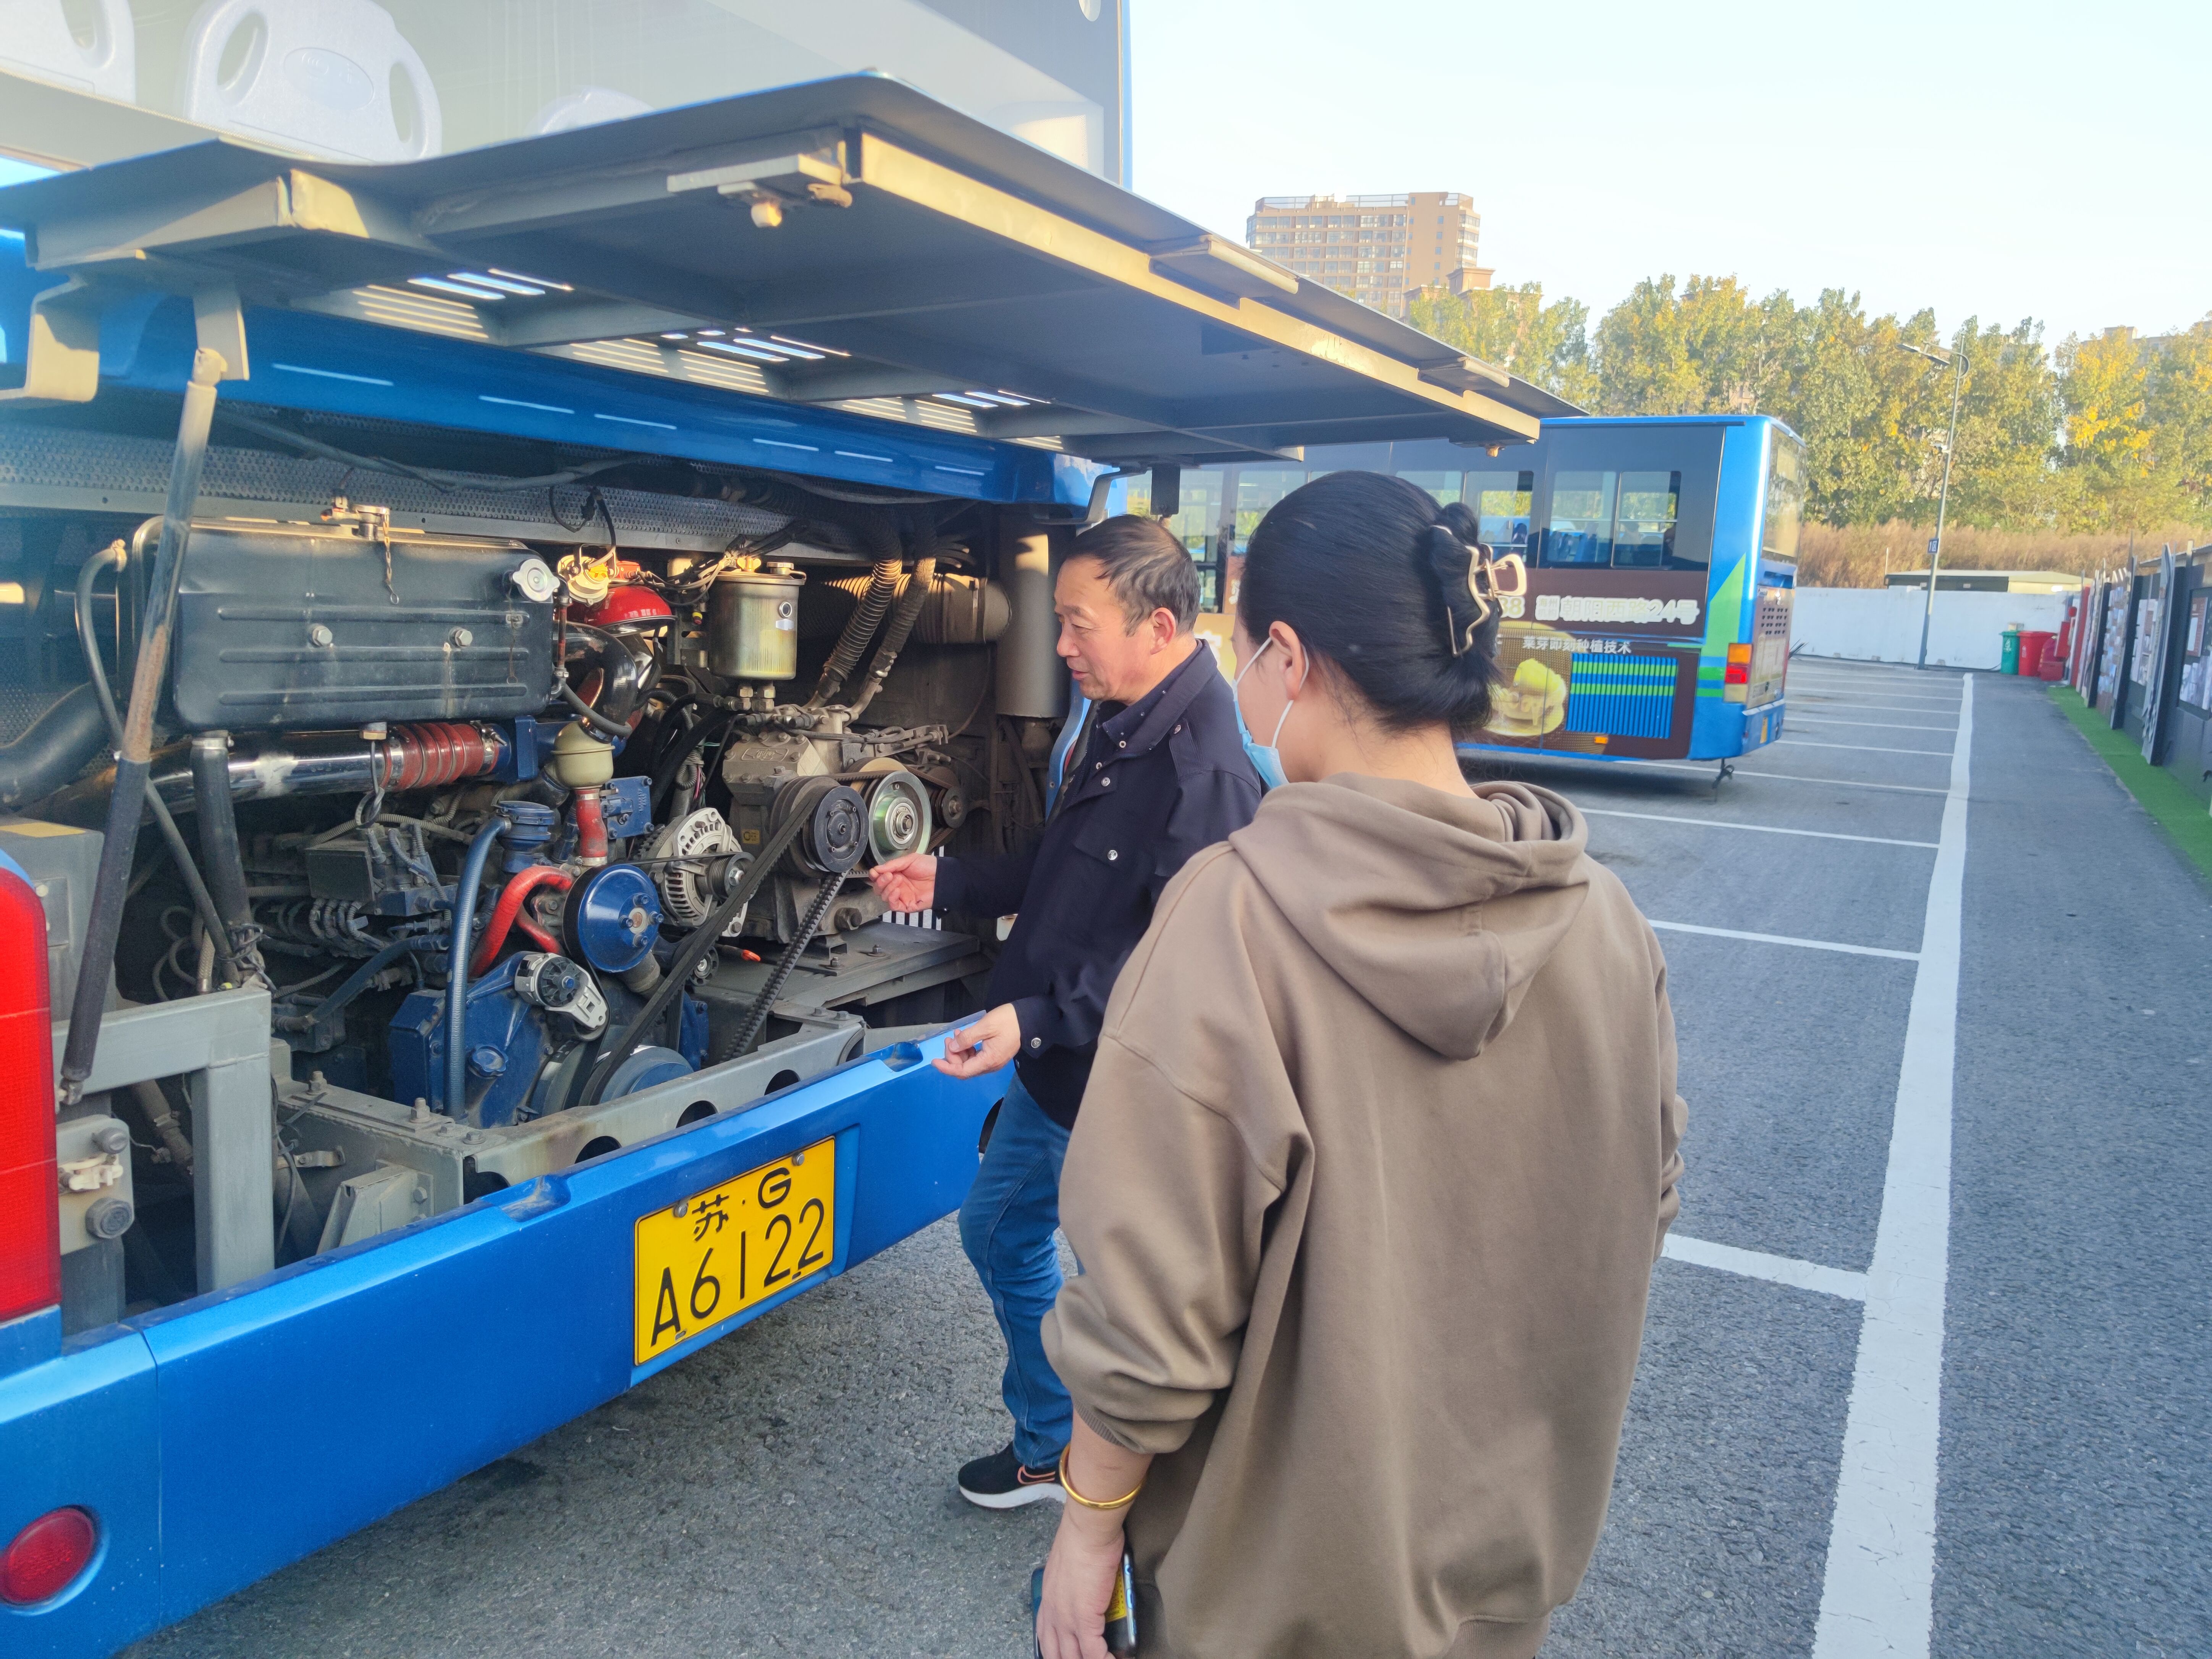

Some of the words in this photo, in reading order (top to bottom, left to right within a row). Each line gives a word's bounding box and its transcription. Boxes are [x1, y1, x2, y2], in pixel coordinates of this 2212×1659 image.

[1560, 596, 1699, 624] 朝阳西路24号
[650, 1198, 825, 1347] A6122
